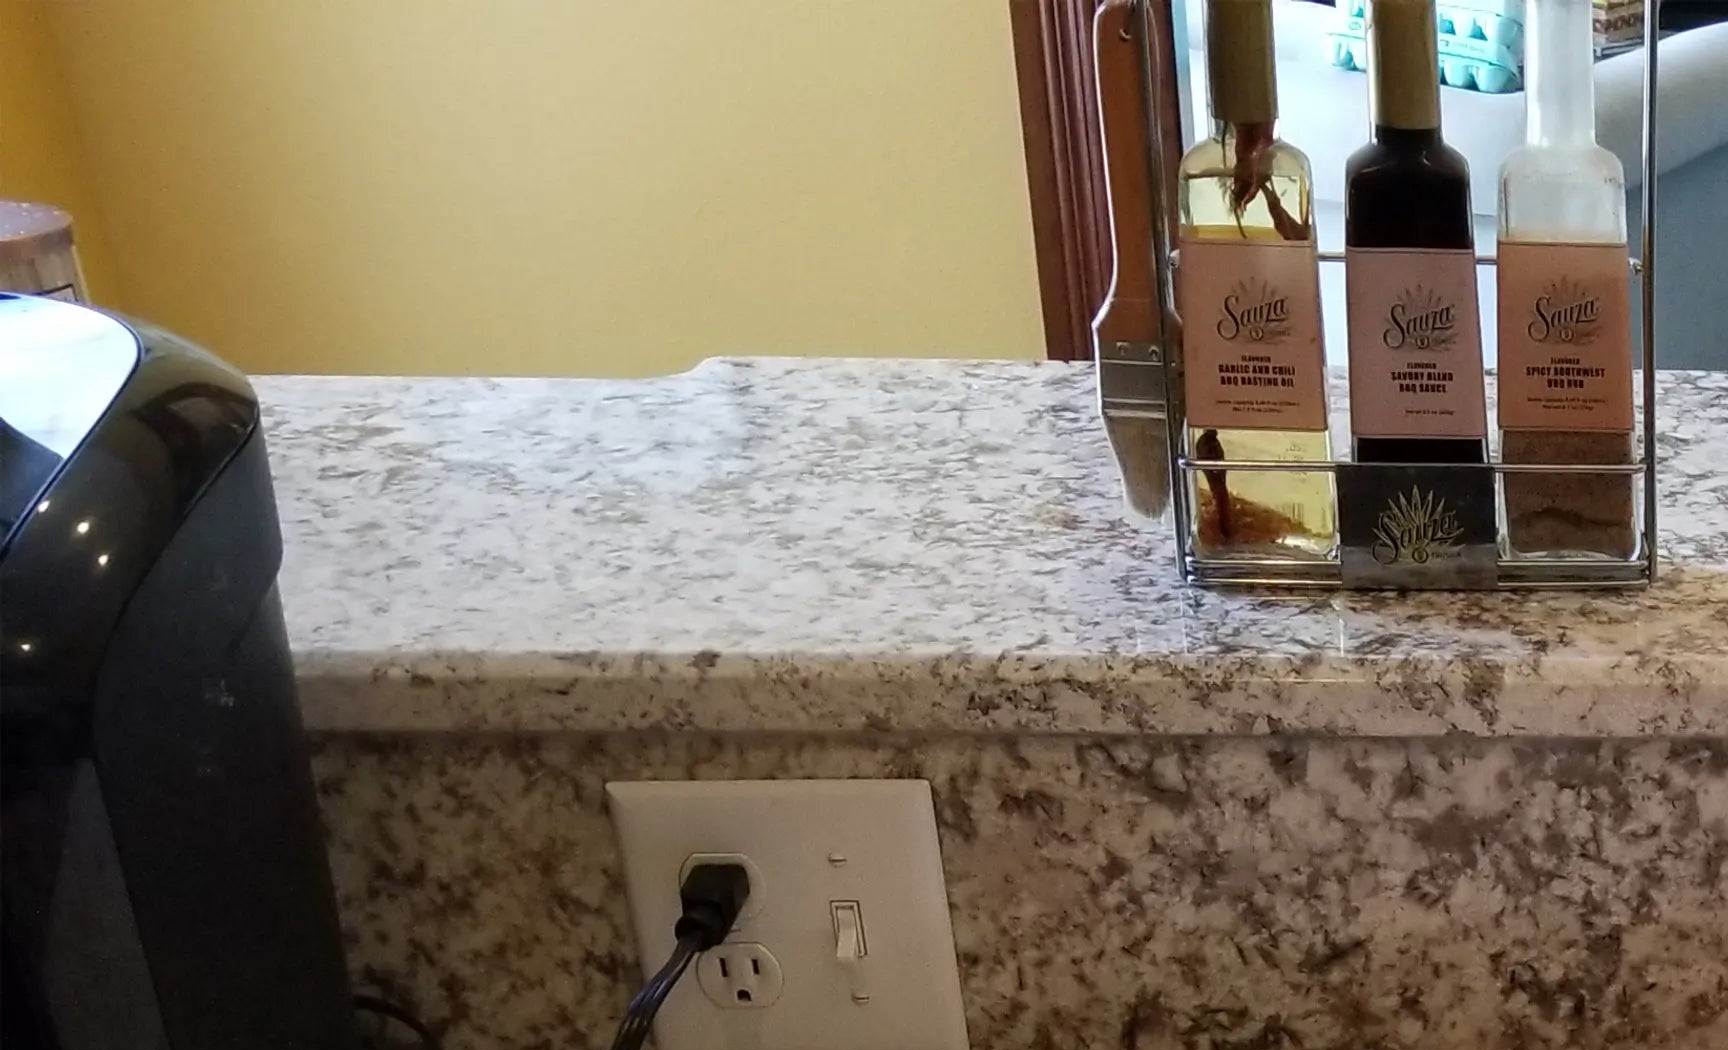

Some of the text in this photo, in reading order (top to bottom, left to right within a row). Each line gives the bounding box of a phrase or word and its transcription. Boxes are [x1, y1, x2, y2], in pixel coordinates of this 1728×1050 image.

[1216, 294, 1288, 341] Sauza
[1527, 296, 1599, 342] Sauza
[1383, 303, 1455, 350] Sauza
[1218, 364, 1296, 376] GARLIC AND CHILI
[1526, 366, 1605, 378] SPICY SOUTHWEST
[1220, 376, 1295, 388] BBQ BASTING OIL
[1391, 371, 1454, 382] SAVORY BLEND
[1399, 383, 1447, 394] BBQ SAUCE
[1371, 509, 1465, 565] Sauza
